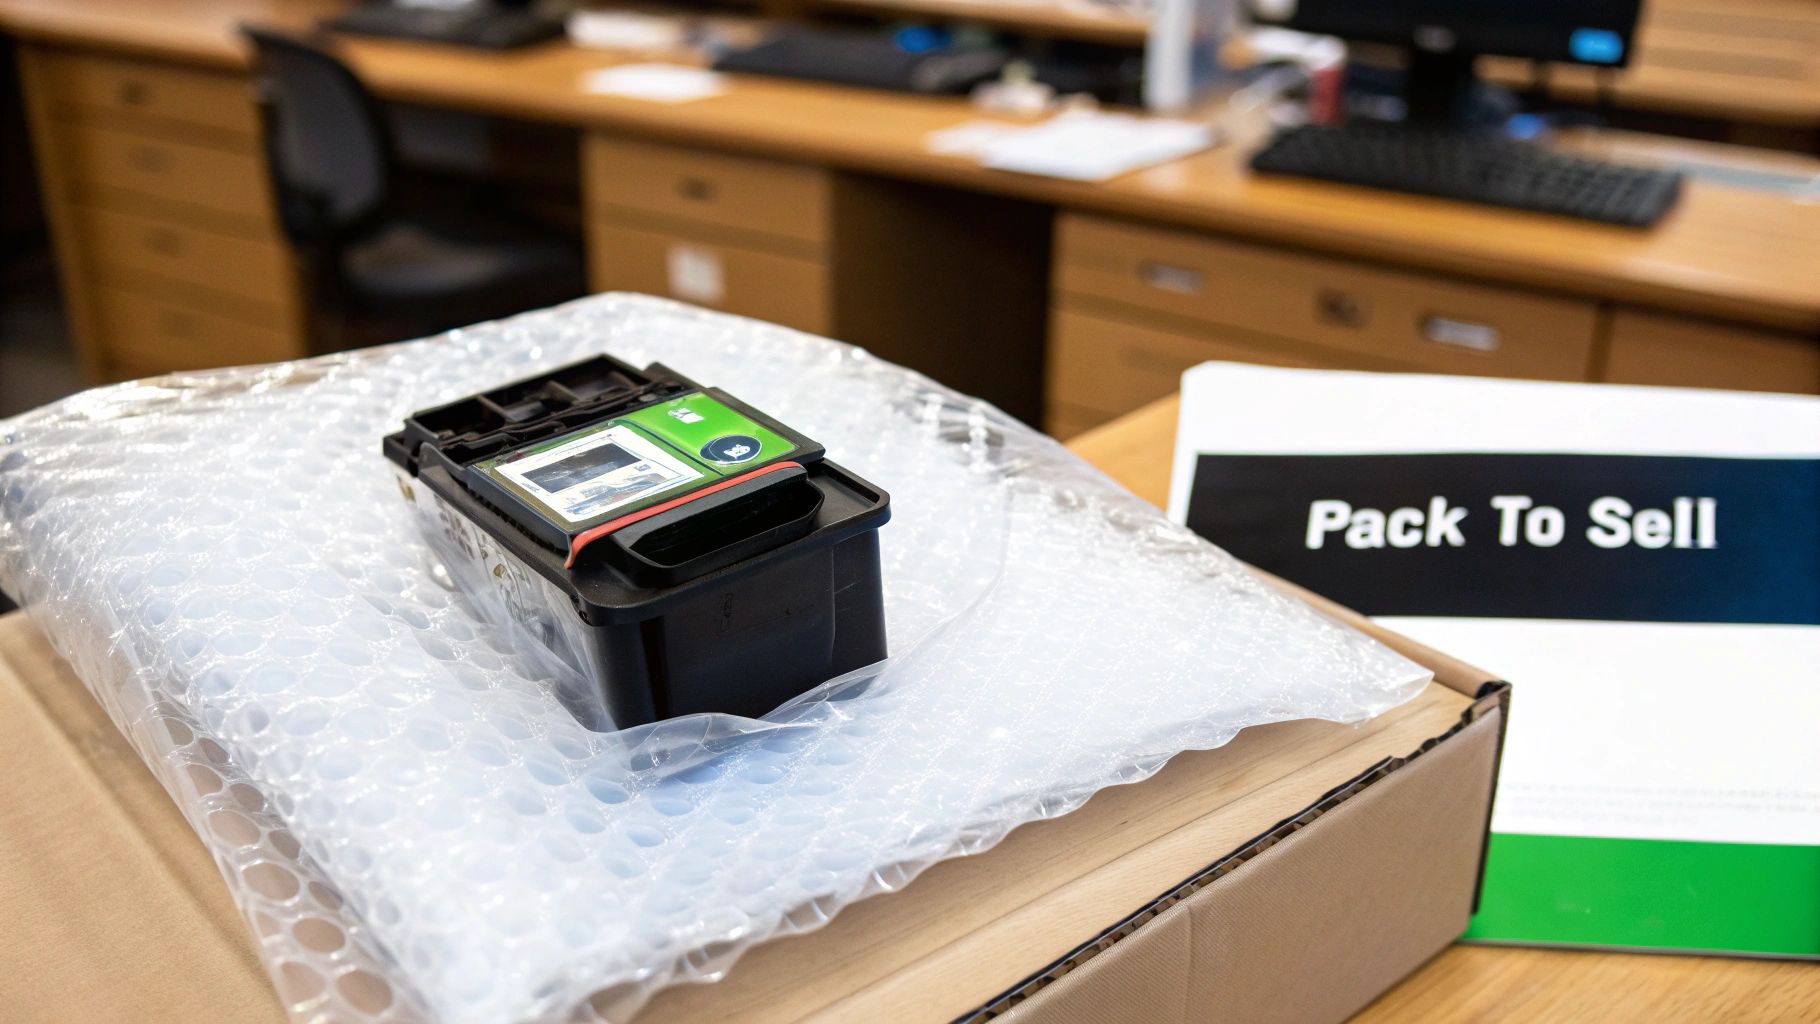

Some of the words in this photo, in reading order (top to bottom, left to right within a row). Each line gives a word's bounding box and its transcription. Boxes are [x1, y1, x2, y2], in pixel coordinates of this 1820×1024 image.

[1305, 496, 1467, 549] Pack
[1490, 495, 1565, 547] To
[1586, 496, 1717, 549] Sell
